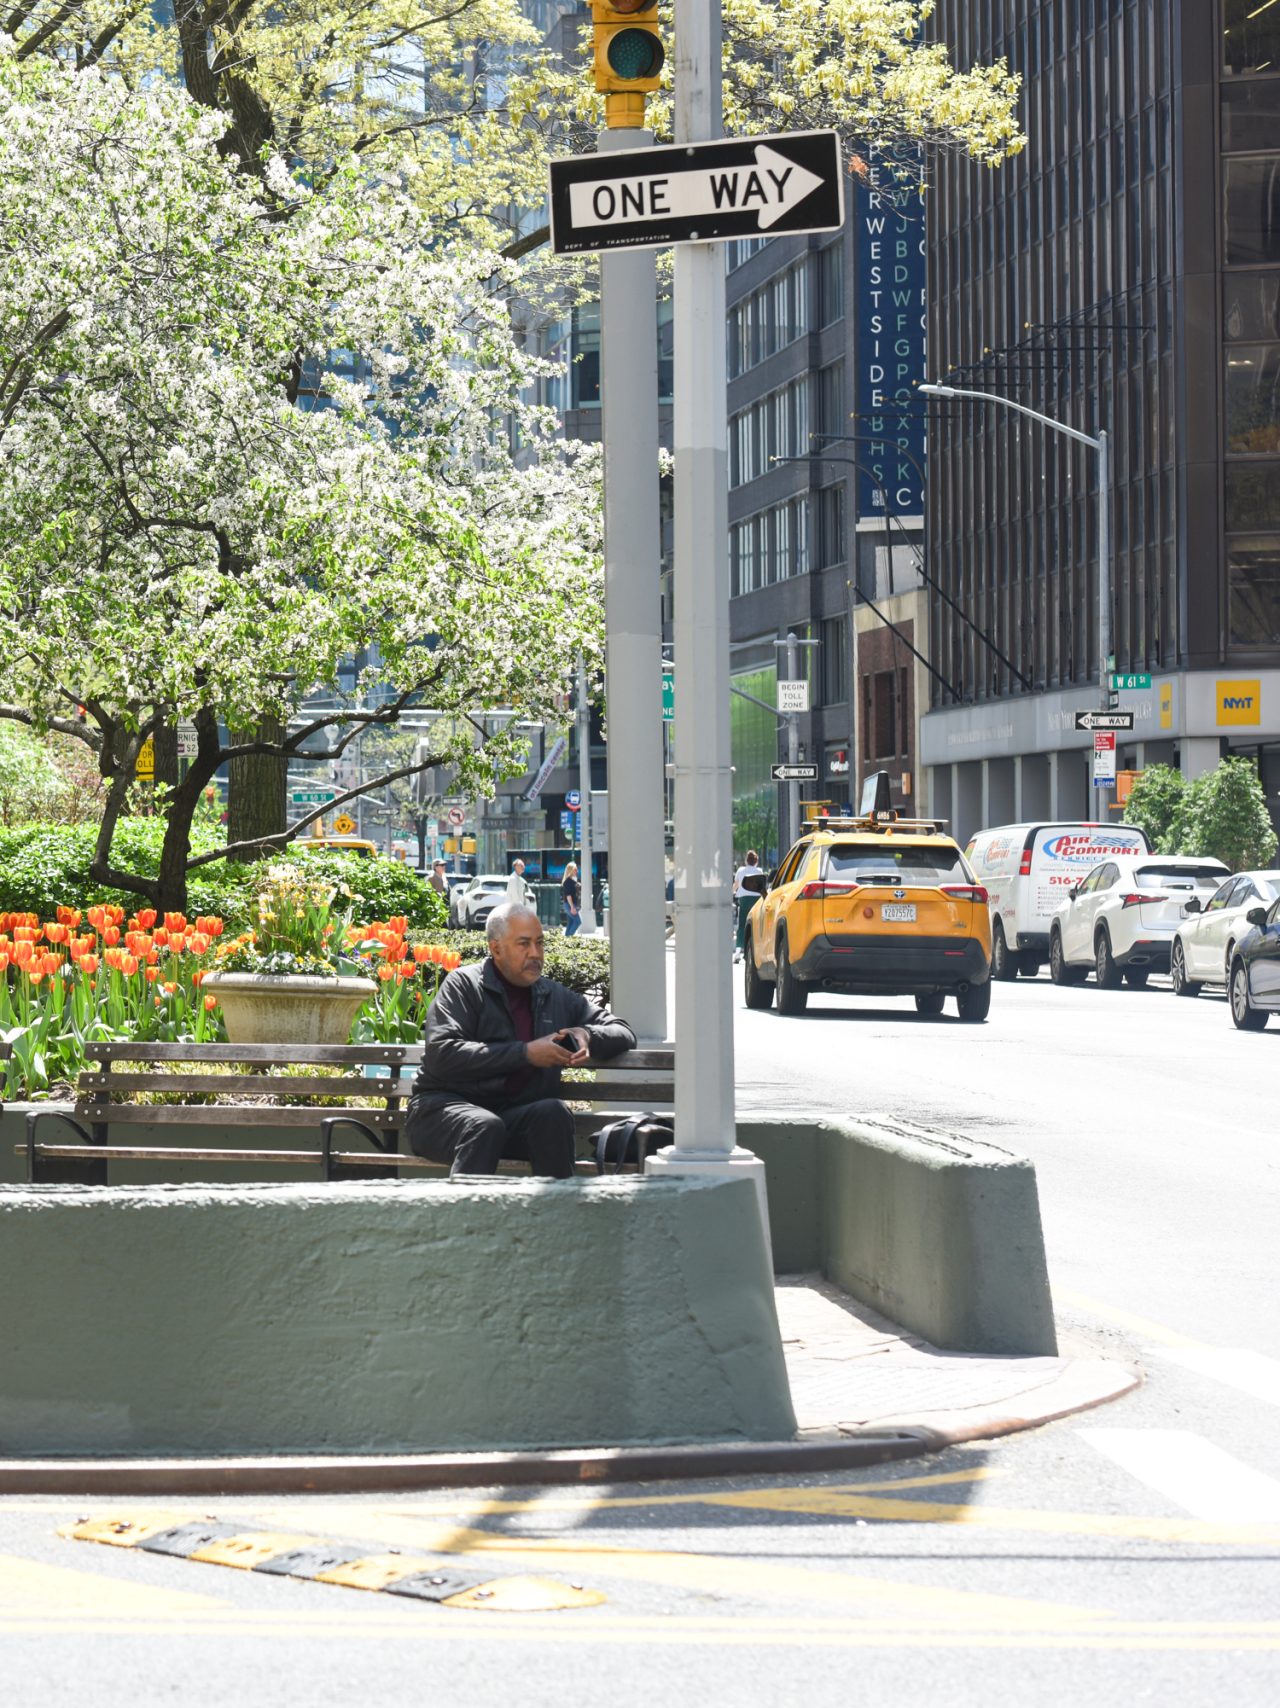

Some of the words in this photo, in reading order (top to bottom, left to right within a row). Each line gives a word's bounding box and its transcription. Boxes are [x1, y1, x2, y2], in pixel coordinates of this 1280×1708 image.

[592, 179, 671, 221] ONE
[709, 167, 794, 209] WAY
[564, 241, 584, 250] DEPT
[590, 240, 600, 248] OF
[606, 233, 671, 247] TRANSPORTATION
[1116, 676, 1124, 688] W
[1127, 676, 1136, 688] 61
[1083, 717, 1101, 726] ONE
[1108, 717, 1127, 726] WAY
[1056, 835, 1091, 854] AIR
[1062, 846, 1140, 856] COMFORT
